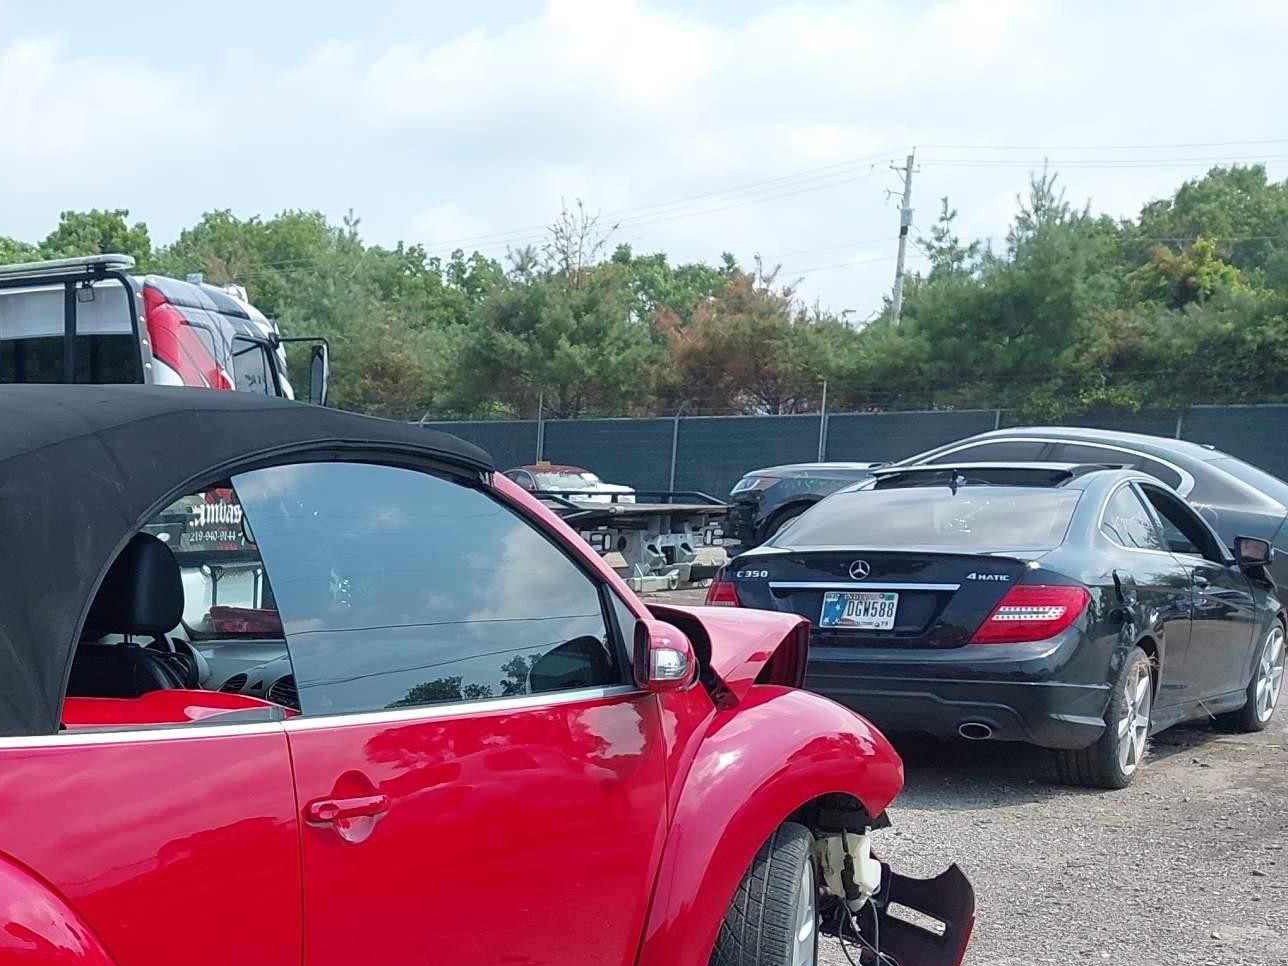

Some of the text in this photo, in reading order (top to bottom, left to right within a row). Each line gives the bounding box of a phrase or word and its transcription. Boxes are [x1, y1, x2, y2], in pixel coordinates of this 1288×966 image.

[736, 570, 769, 578] C 350
[847, 600, 895, 618] DGW588
